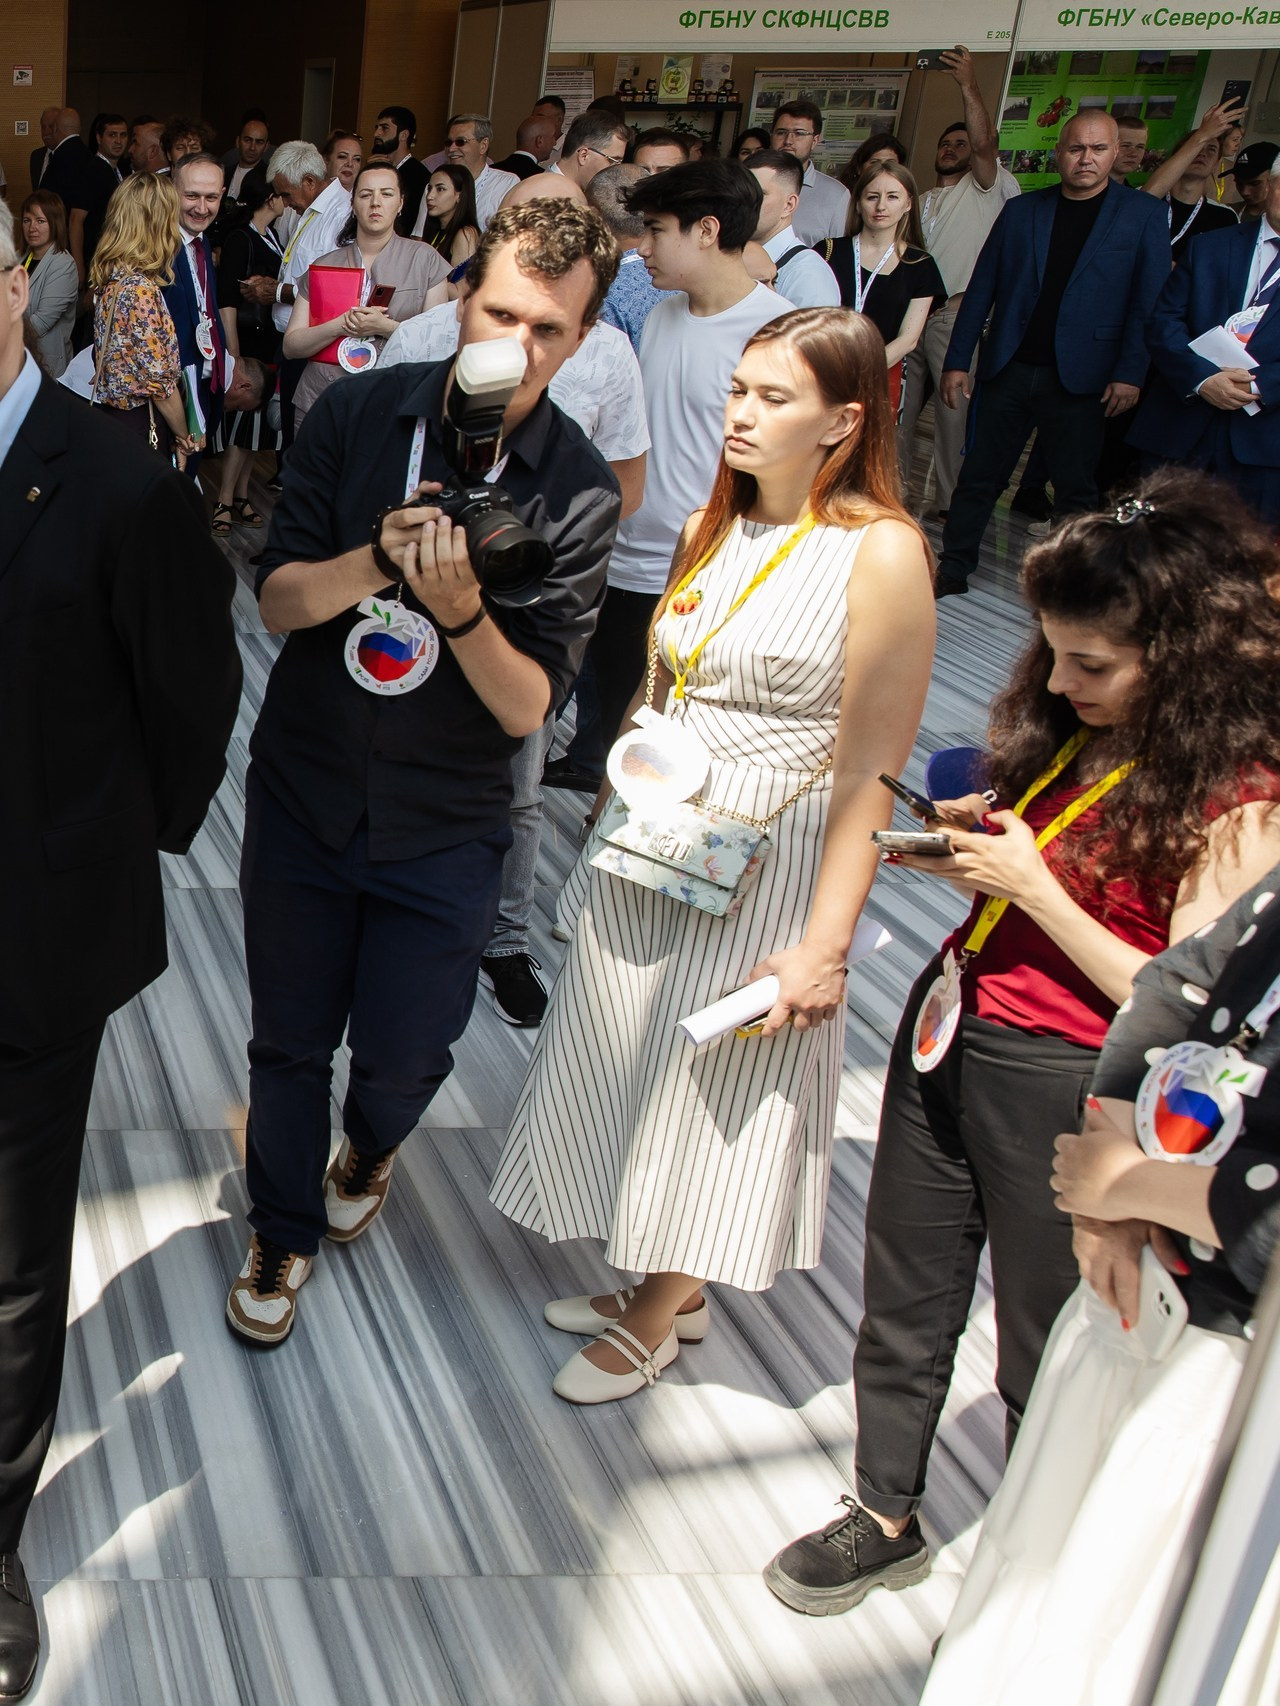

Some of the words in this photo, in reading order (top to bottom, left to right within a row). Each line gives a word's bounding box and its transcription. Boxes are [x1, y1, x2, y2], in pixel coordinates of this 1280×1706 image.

[678, 9, 757, 29] ФГБНУ
[761, 9, 890, 32] СКФНЦСВВ
[1056, 8, 1137, 27] ФГБНУ
[994, 30, 1011, 39] 205
